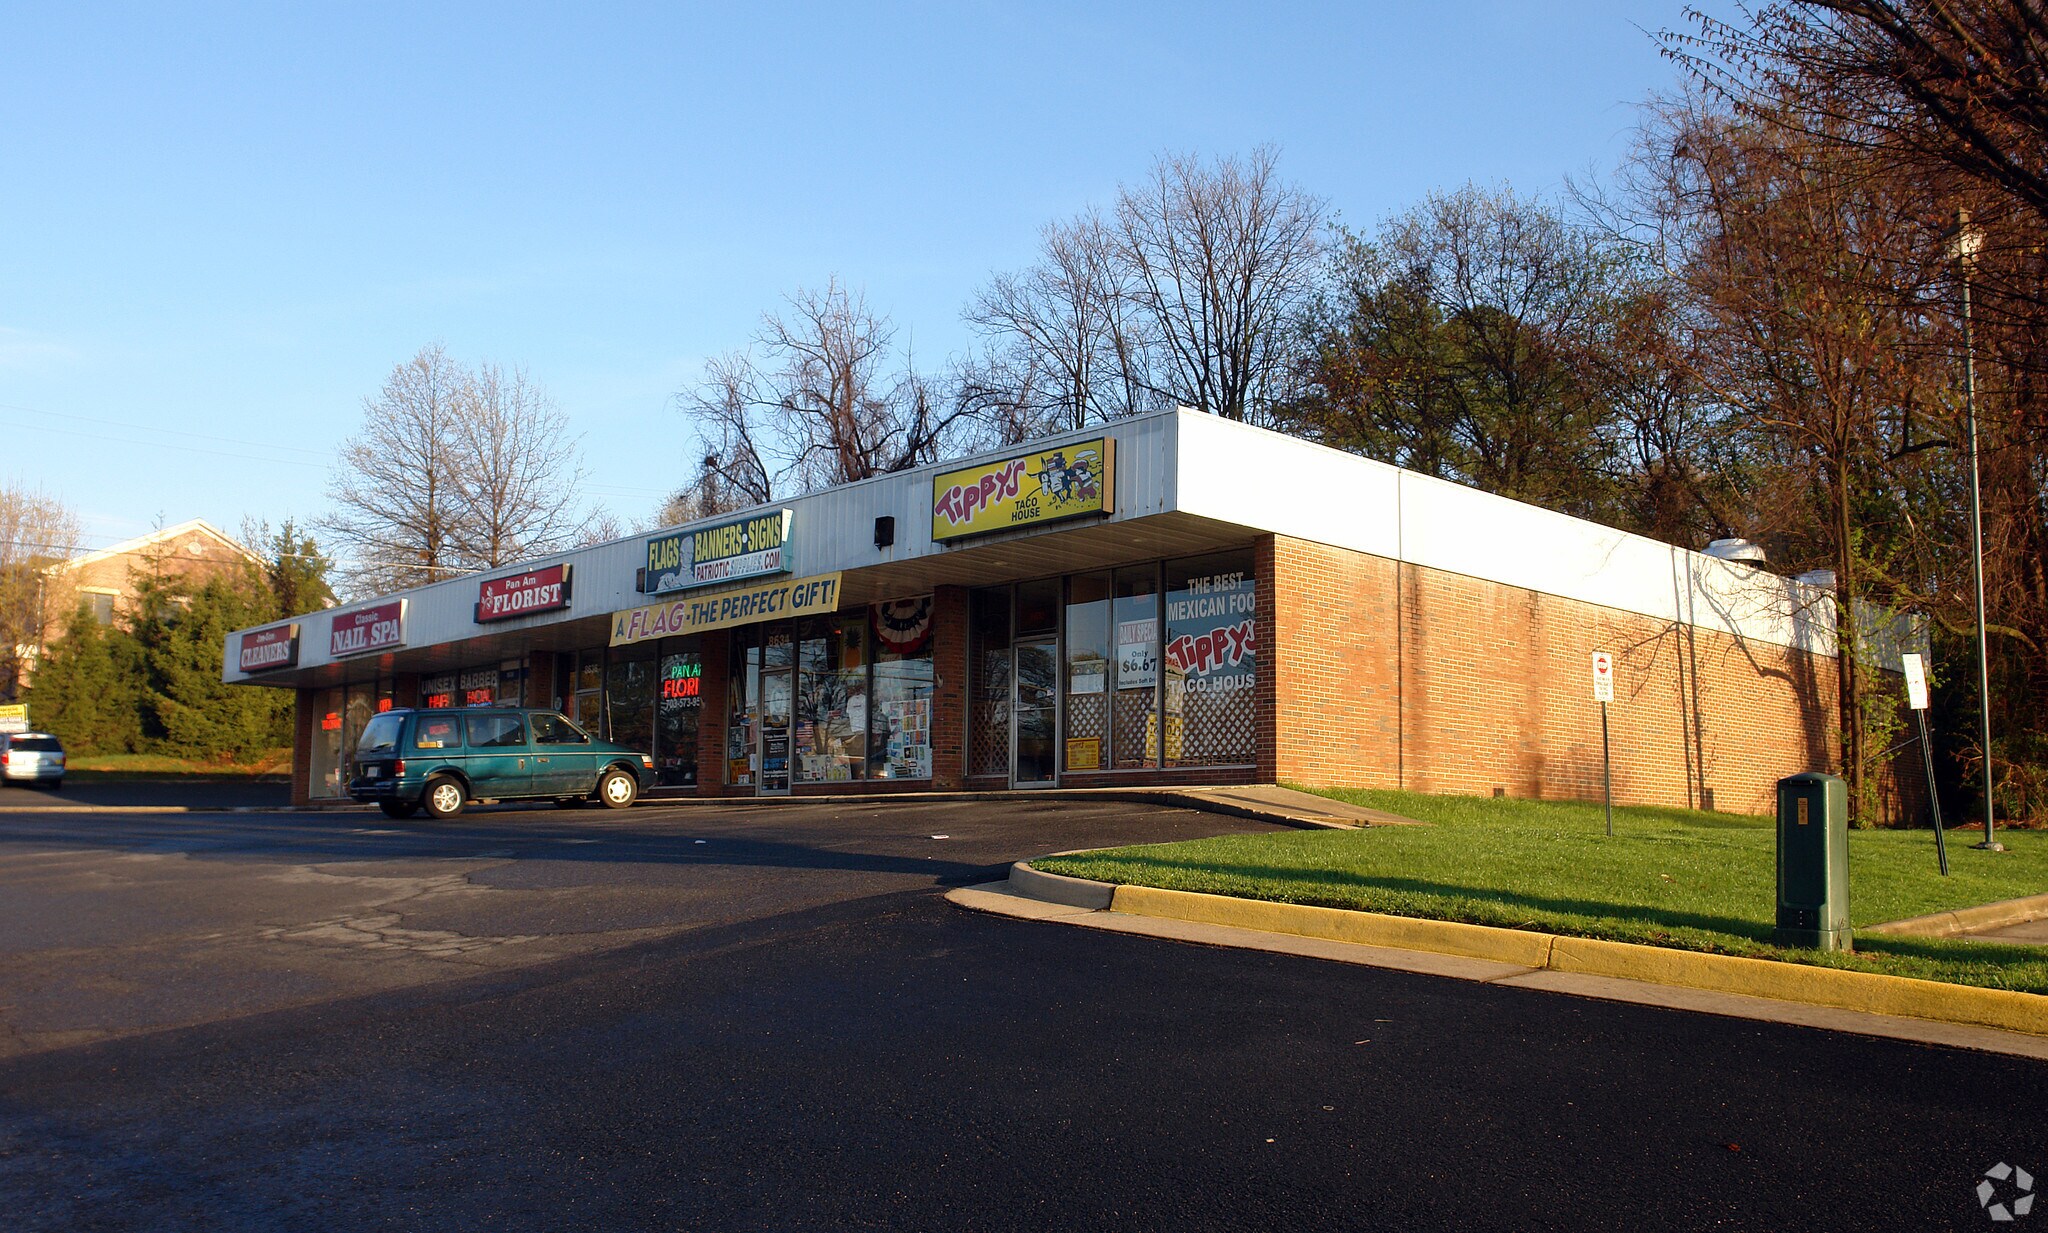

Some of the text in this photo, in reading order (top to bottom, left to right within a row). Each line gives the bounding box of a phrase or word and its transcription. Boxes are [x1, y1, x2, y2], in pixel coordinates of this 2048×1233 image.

[1011, 506, 1041, 522] HOUSE
[1015, 497, 1038, 510] TACO
[648, 515, 780, 571] FLAGS BANNERS SIGNS
[505, 576, 536, 590] Pan Am
[1187, 571, 1244, 596] THE BEST
[492, 582, 561, 614] FLORIST
[1168, 592, 1256, 622] MEXICAN FOO
[355, 611, 379, 625] Classic
[615, 617, 625, 638] A
[626, 603, 686, 641] FLAG
[720, 587, 789, 621] PERFECT
[792, 579, 836, 608] GIFT!
[332, 618, 399, 653] NAIL SPA
[1120, 624, 1137, 645] DAILY
[241, 640, 289, 667] CLEANERS
[1131, 650, 1149, 658] Only
[671, 664, 690, 679] PAN
[1122, 657, 1157, 673] $6.67
[421, 670, 497, 695] UNISEX BARBER
[664, 677, 699, 698] FLORI
[1168, 673, 1255, 694] TACO HOUS
